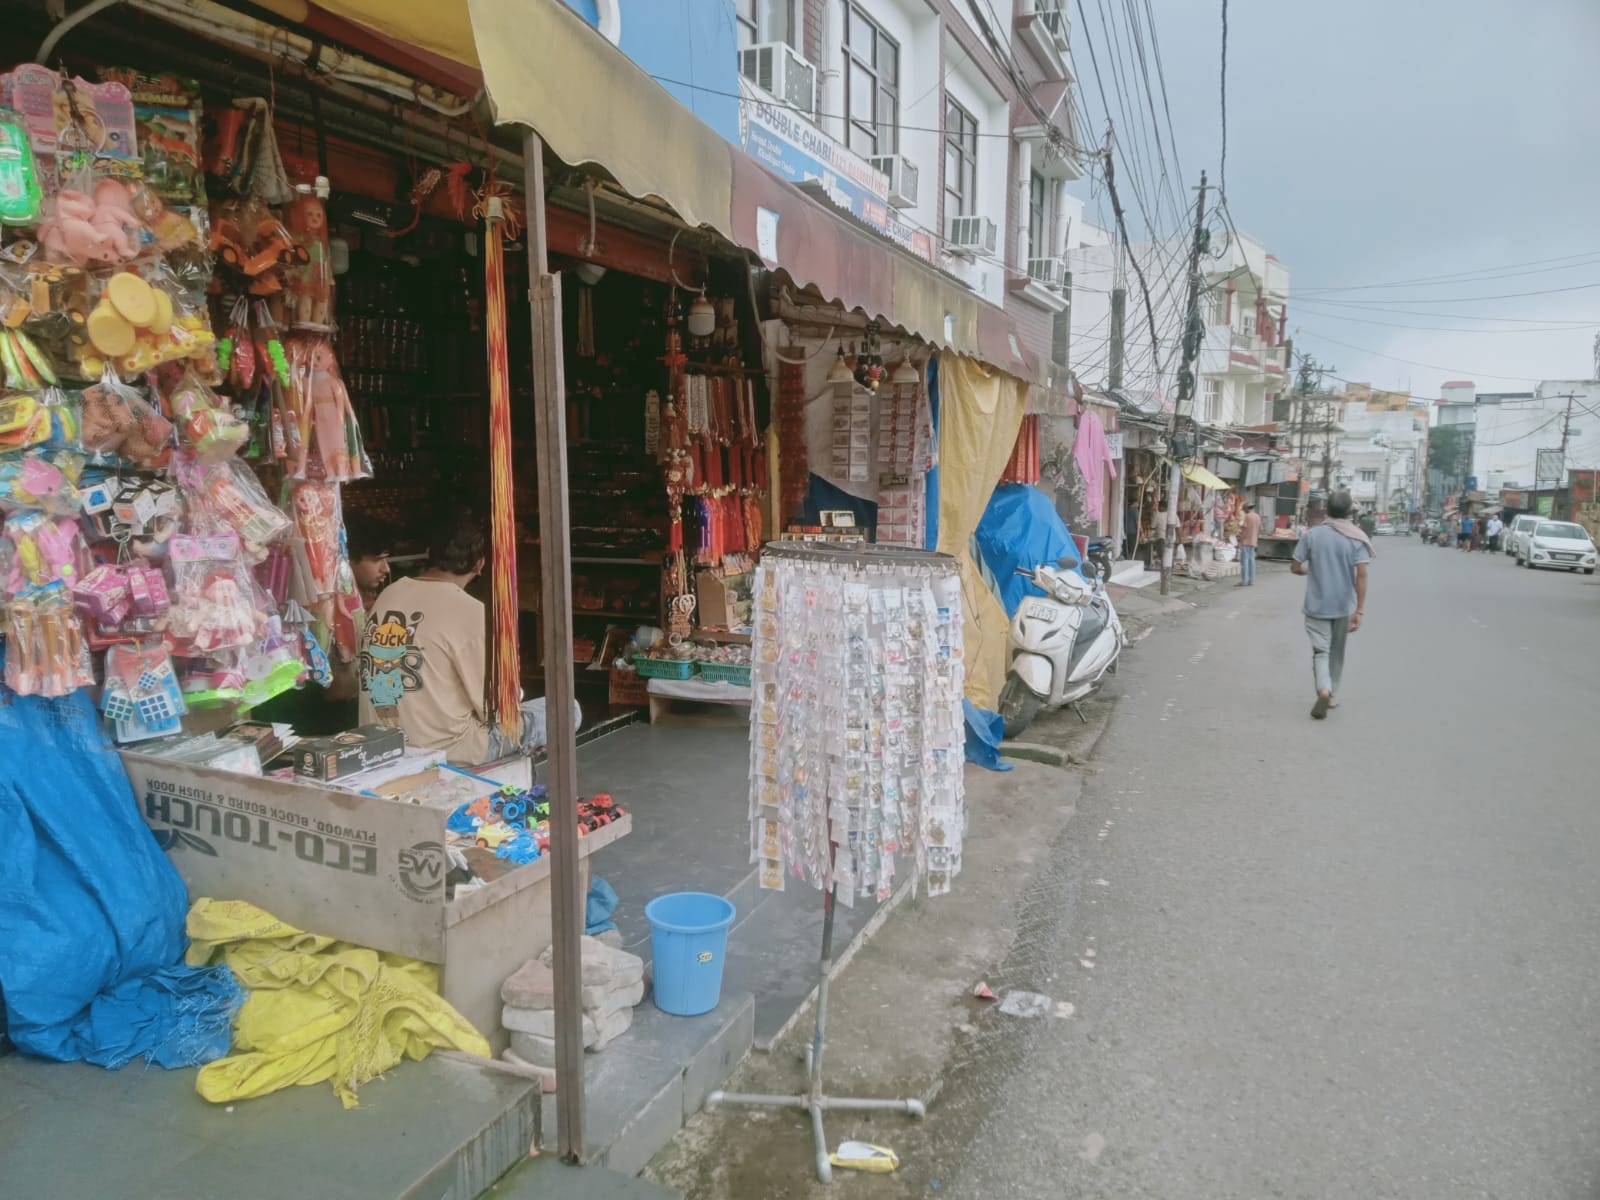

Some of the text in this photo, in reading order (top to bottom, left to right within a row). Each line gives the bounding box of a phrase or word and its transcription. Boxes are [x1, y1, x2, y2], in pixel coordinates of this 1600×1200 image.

[756, 102, 801, 142] DOUBLE
[373, 632, 406, 647] SUCK
[179, 785, 212, 802] FLUSH
[217, 794, 224, 804] &
[228, 796, 267, 815] BOARD
[270, 807, 309, 827] BLOCK
[145, 791, 377, 877] ECO-TOUCH
